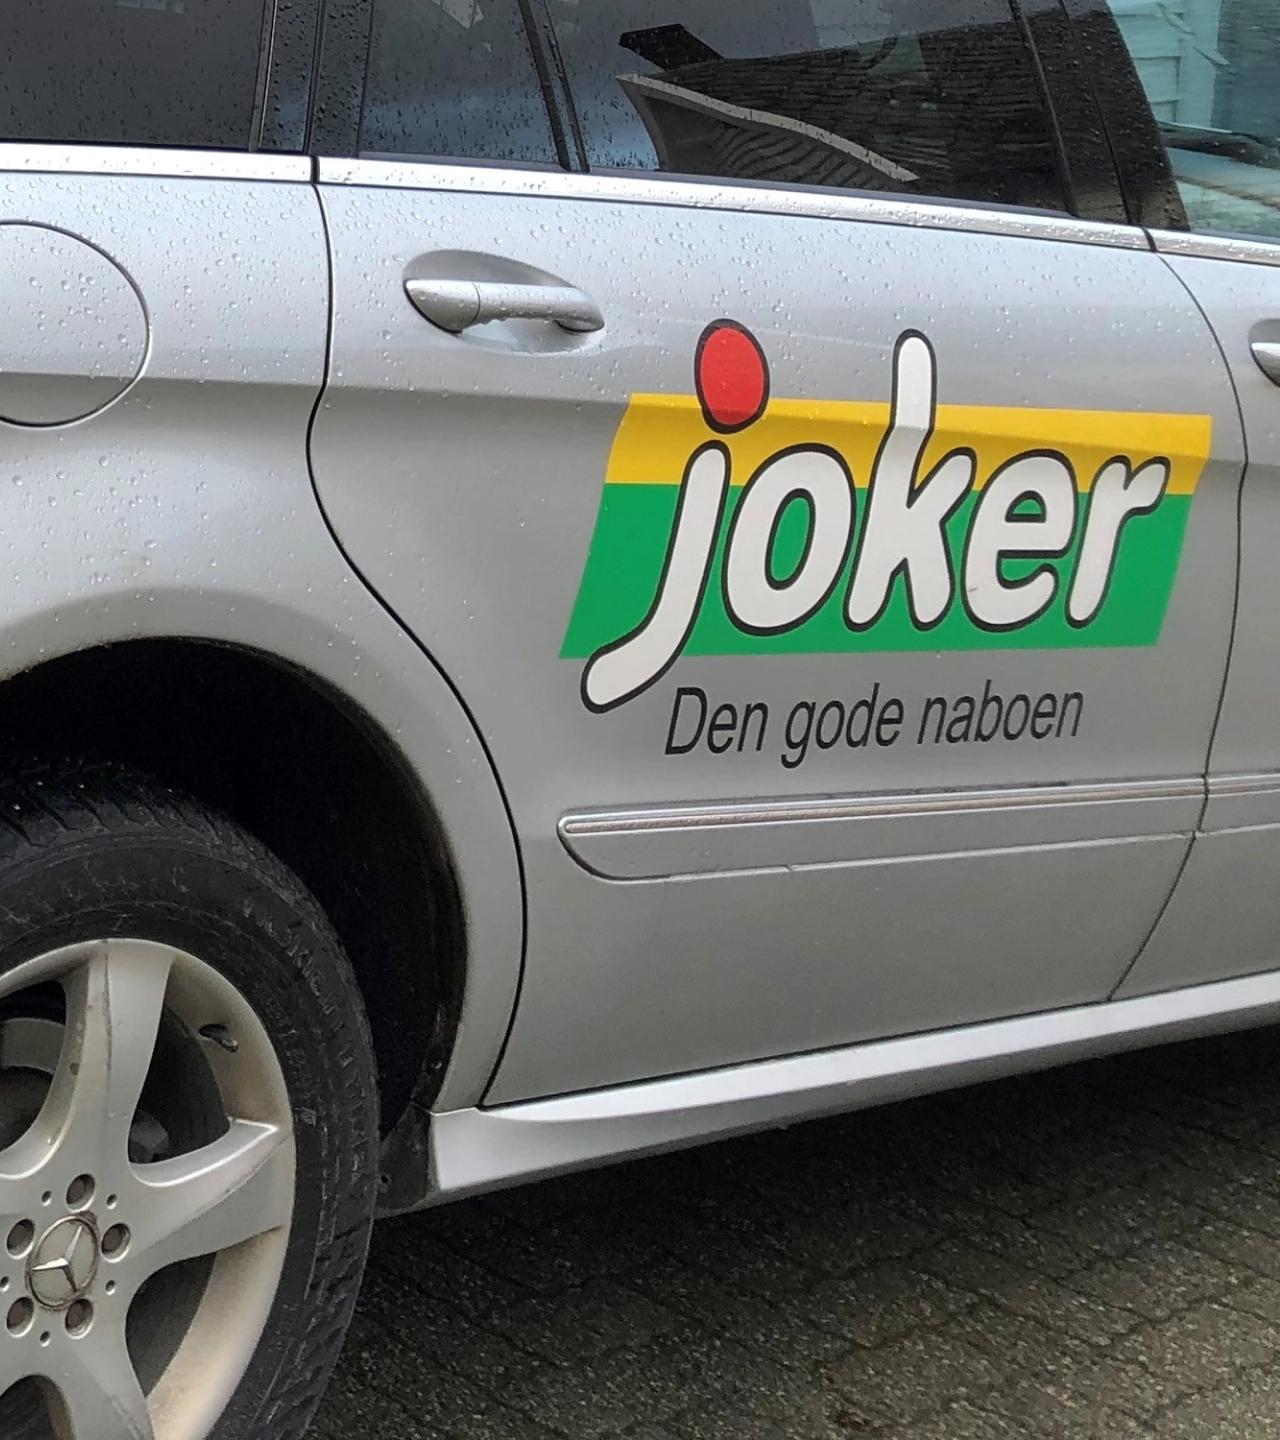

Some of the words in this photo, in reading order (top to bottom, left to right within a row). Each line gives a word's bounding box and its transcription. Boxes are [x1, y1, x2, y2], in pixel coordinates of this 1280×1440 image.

[581, 319, 1171, 713] joker
[665, 685, 768, 755] Den
[781, 683, 903, 768] gode
[917, 680, 1084, 746] naboen
